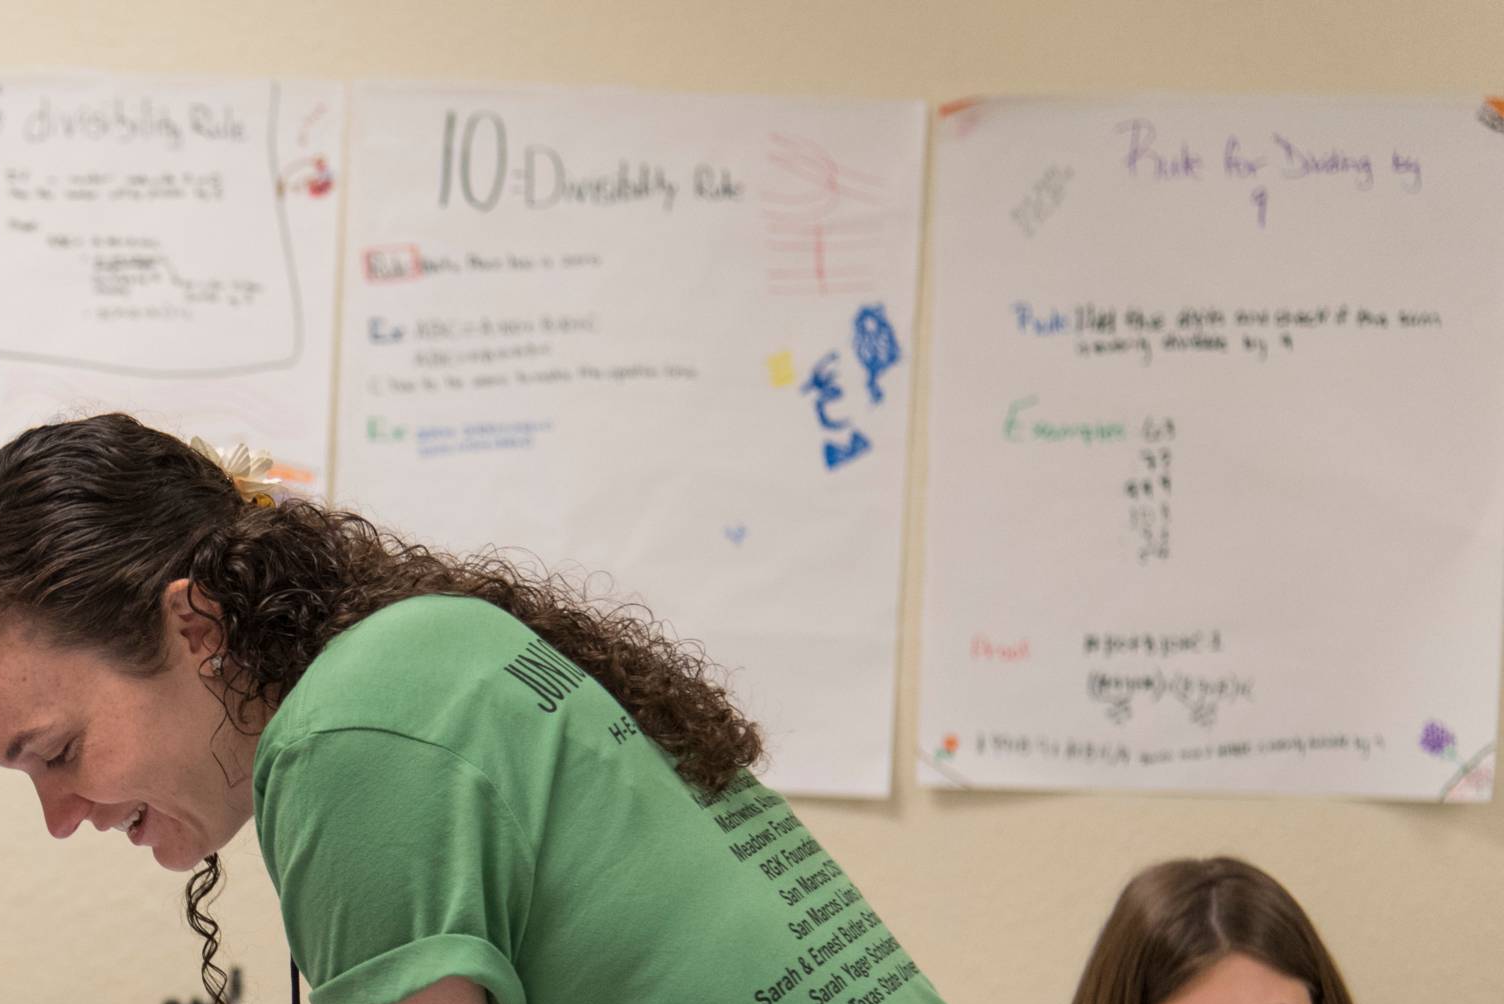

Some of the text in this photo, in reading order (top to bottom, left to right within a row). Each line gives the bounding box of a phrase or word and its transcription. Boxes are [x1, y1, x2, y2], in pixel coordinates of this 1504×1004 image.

[728, 828, 777, 863] Meadows
[759, 854, 789, 881] RGK
[779, 886, 804, 907] San
[796, 869, 832, 895] Marcos
[788, 918, 814, 940] San
[806, 898, 843, 926] Marcos
[798, 956, 814, 975] &
[808, 932, 847, 967] Ernest
[837, 919, 867, 944] Butler
[840, 954, 873, 982] Yager
[877, 971, 903, 995] State
